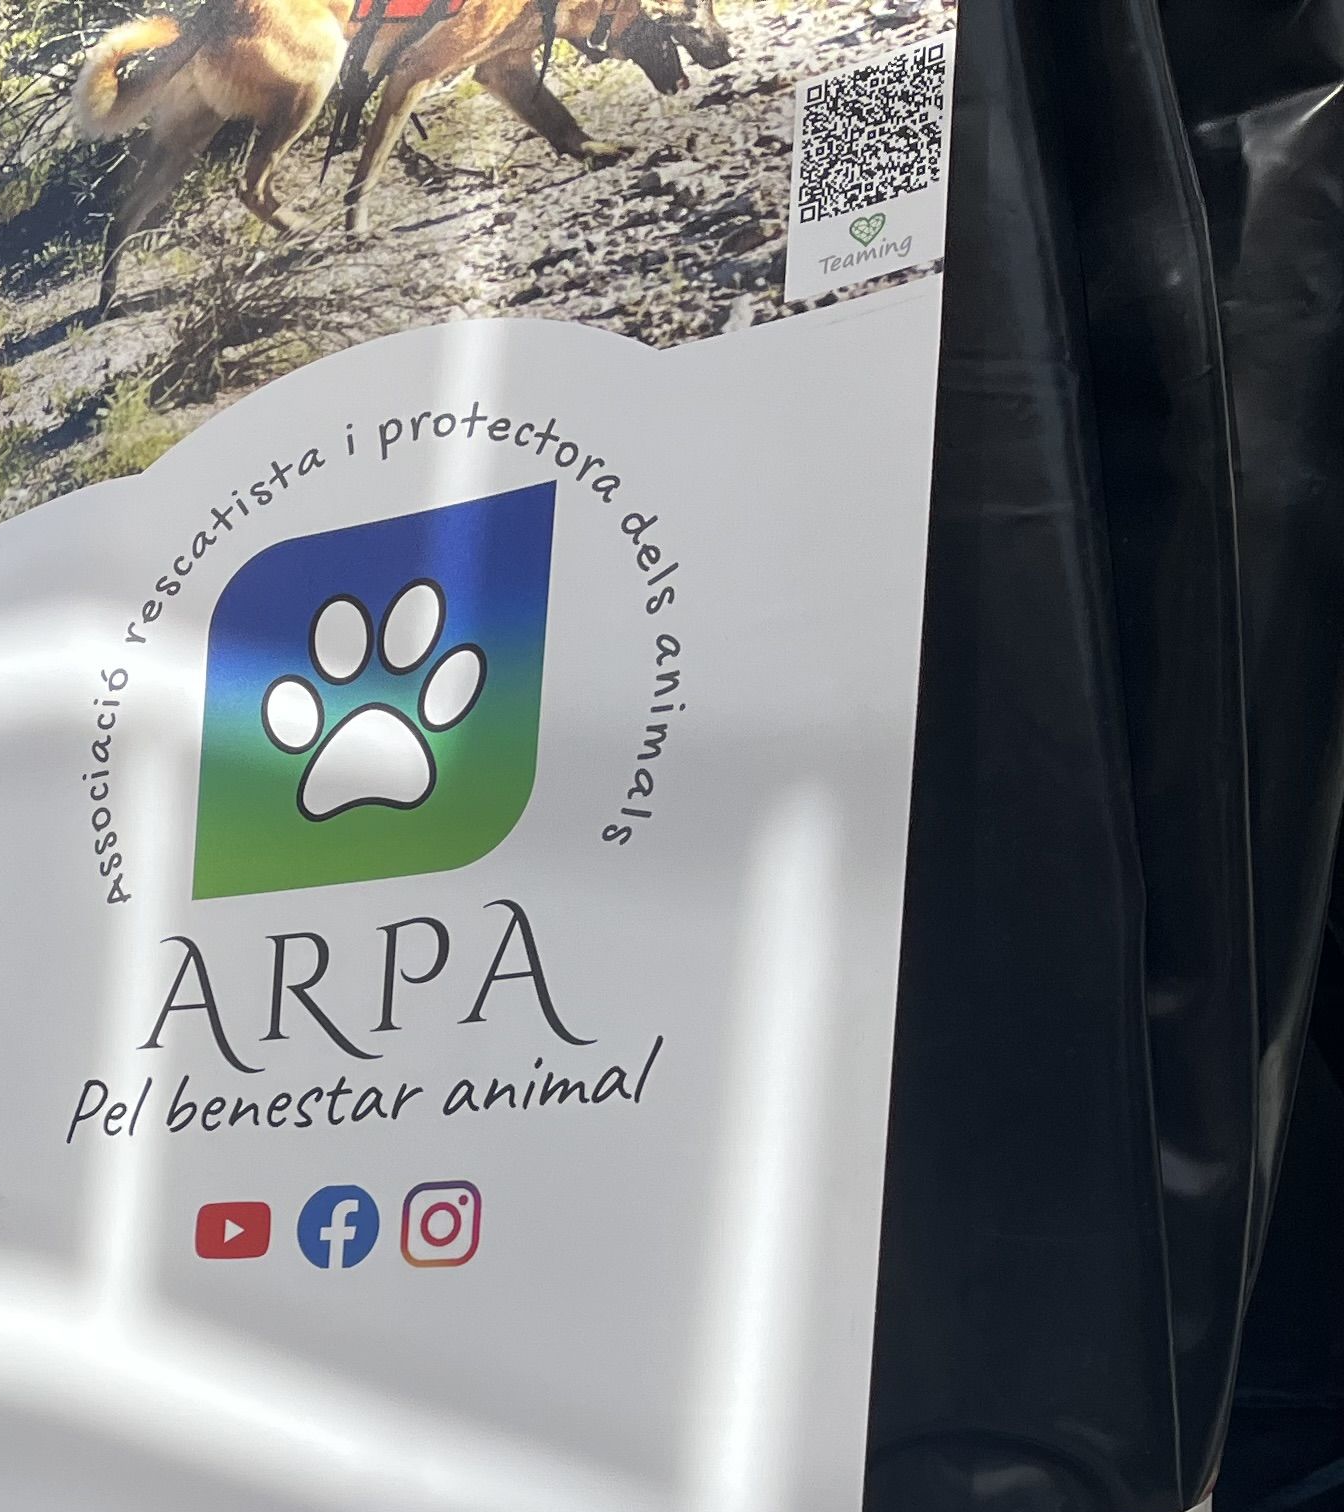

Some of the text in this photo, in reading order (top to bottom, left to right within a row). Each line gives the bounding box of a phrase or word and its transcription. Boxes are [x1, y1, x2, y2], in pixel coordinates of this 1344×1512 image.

[818, 235, 913, 275] Teaming
[81, 401, 686, 904] Associació rescatista i protectora dels animals
[137, 900, 596, 1072] ARPA
[67, 1037, 664, 1143] Pel benestar animal
